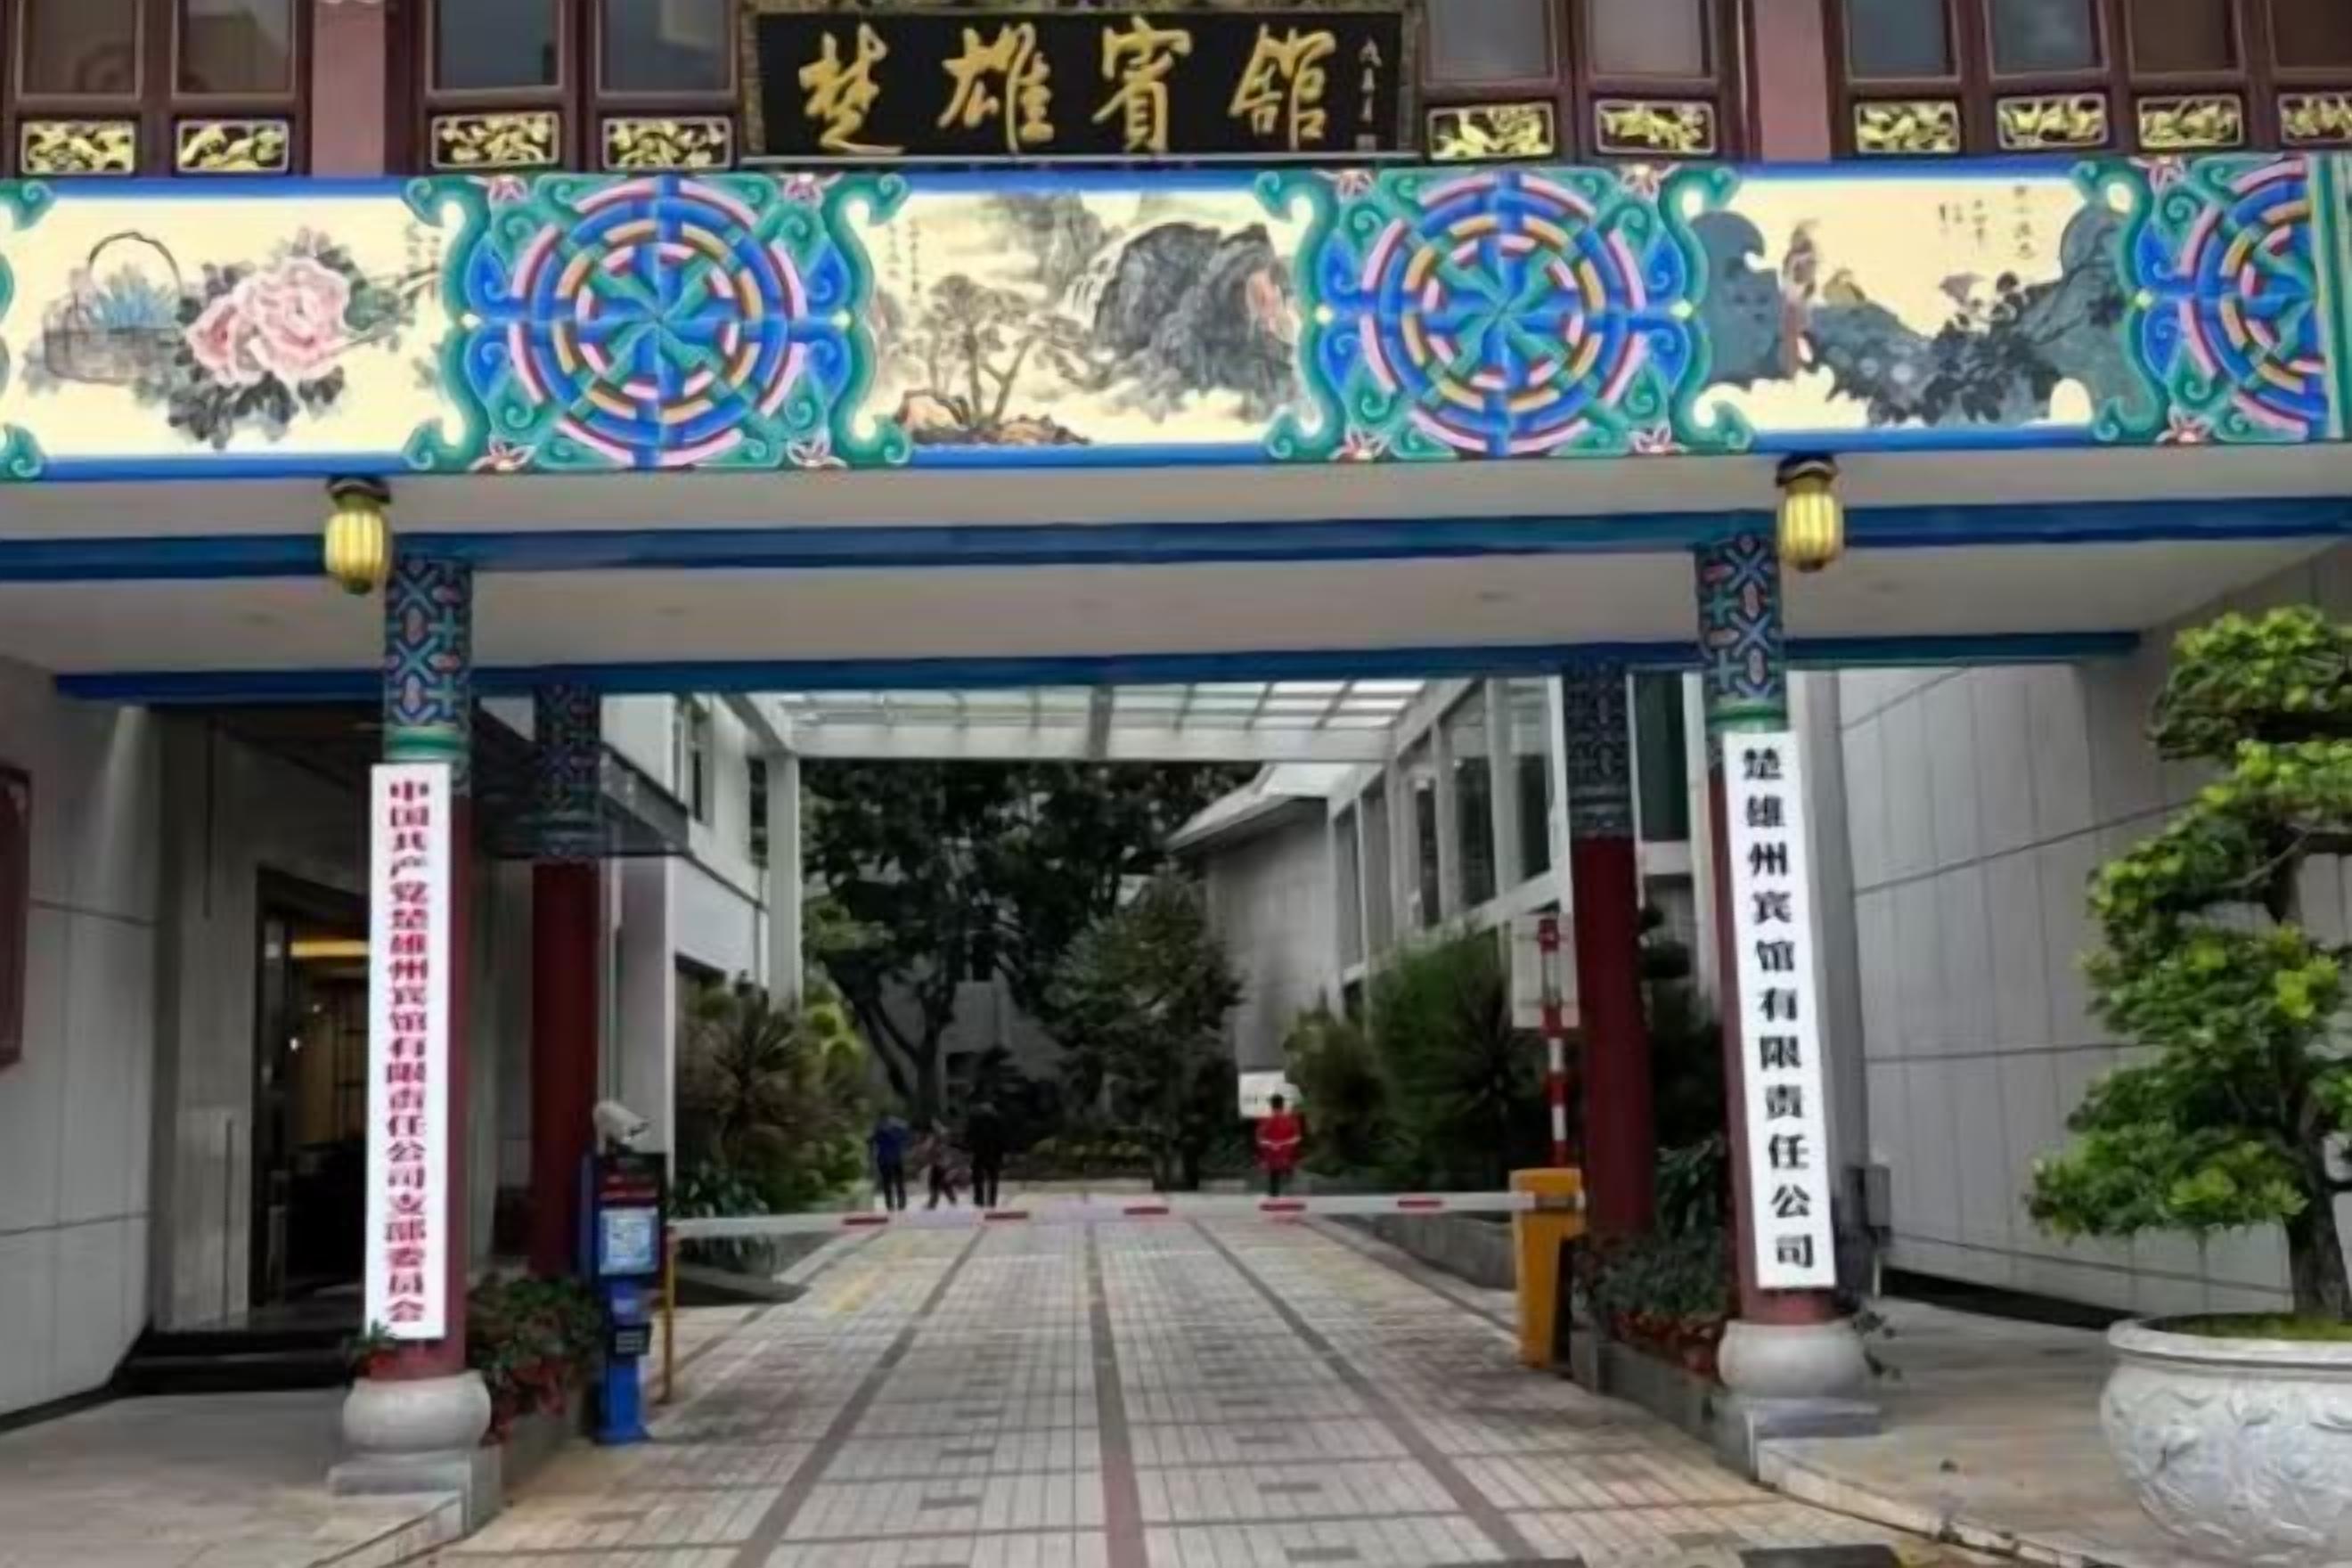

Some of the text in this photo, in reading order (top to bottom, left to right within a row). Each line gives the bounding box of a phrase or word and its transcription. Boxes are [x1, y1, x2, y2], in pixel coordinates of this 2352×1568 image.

[385, 780, 430, 1323] 中国共产党楚雄州宾馆有限责任公司支部委员会
[1743, 747, 1816, 1270] 楚雄州宾馆有限责任公司
